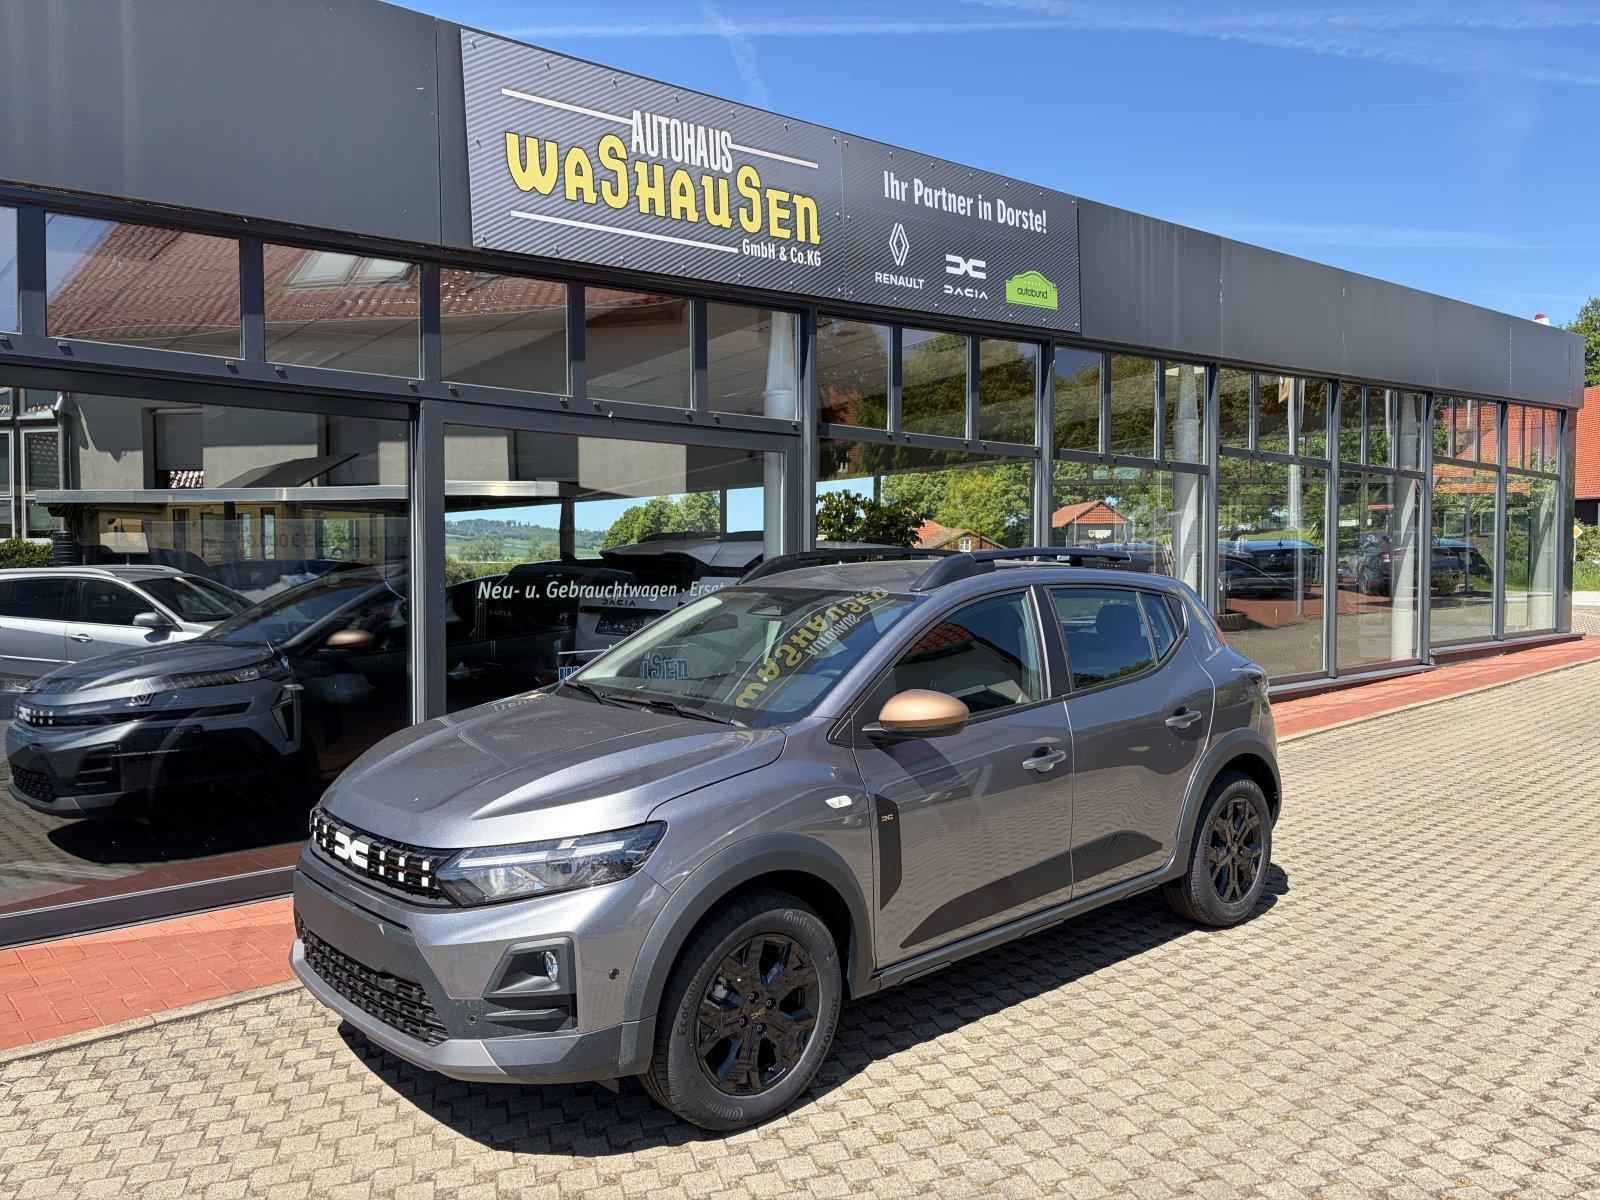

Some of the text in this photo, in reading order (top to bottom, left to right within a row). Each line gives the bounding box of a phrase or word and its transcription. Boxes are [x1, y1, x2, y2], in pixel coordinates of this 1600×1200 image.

[632, 109, 733, 174] AUTOHAUS
[883, 170, 1047, 234] Ihr Partner in Dorste!
[742, 238, 822, 267] GmbH & Co.KG
[875, 272, 925, 290] RENAULT
[943, 284, 989, 300] DACIA
[1017, 286, 1048, 299] autobund
[477, 581, 520, 599] Neu-
[525, 585, 541, 599] u.
[546, 580, 677, 602] Gebrauchtwagen
[602, 598, 636, 607] DACIA
